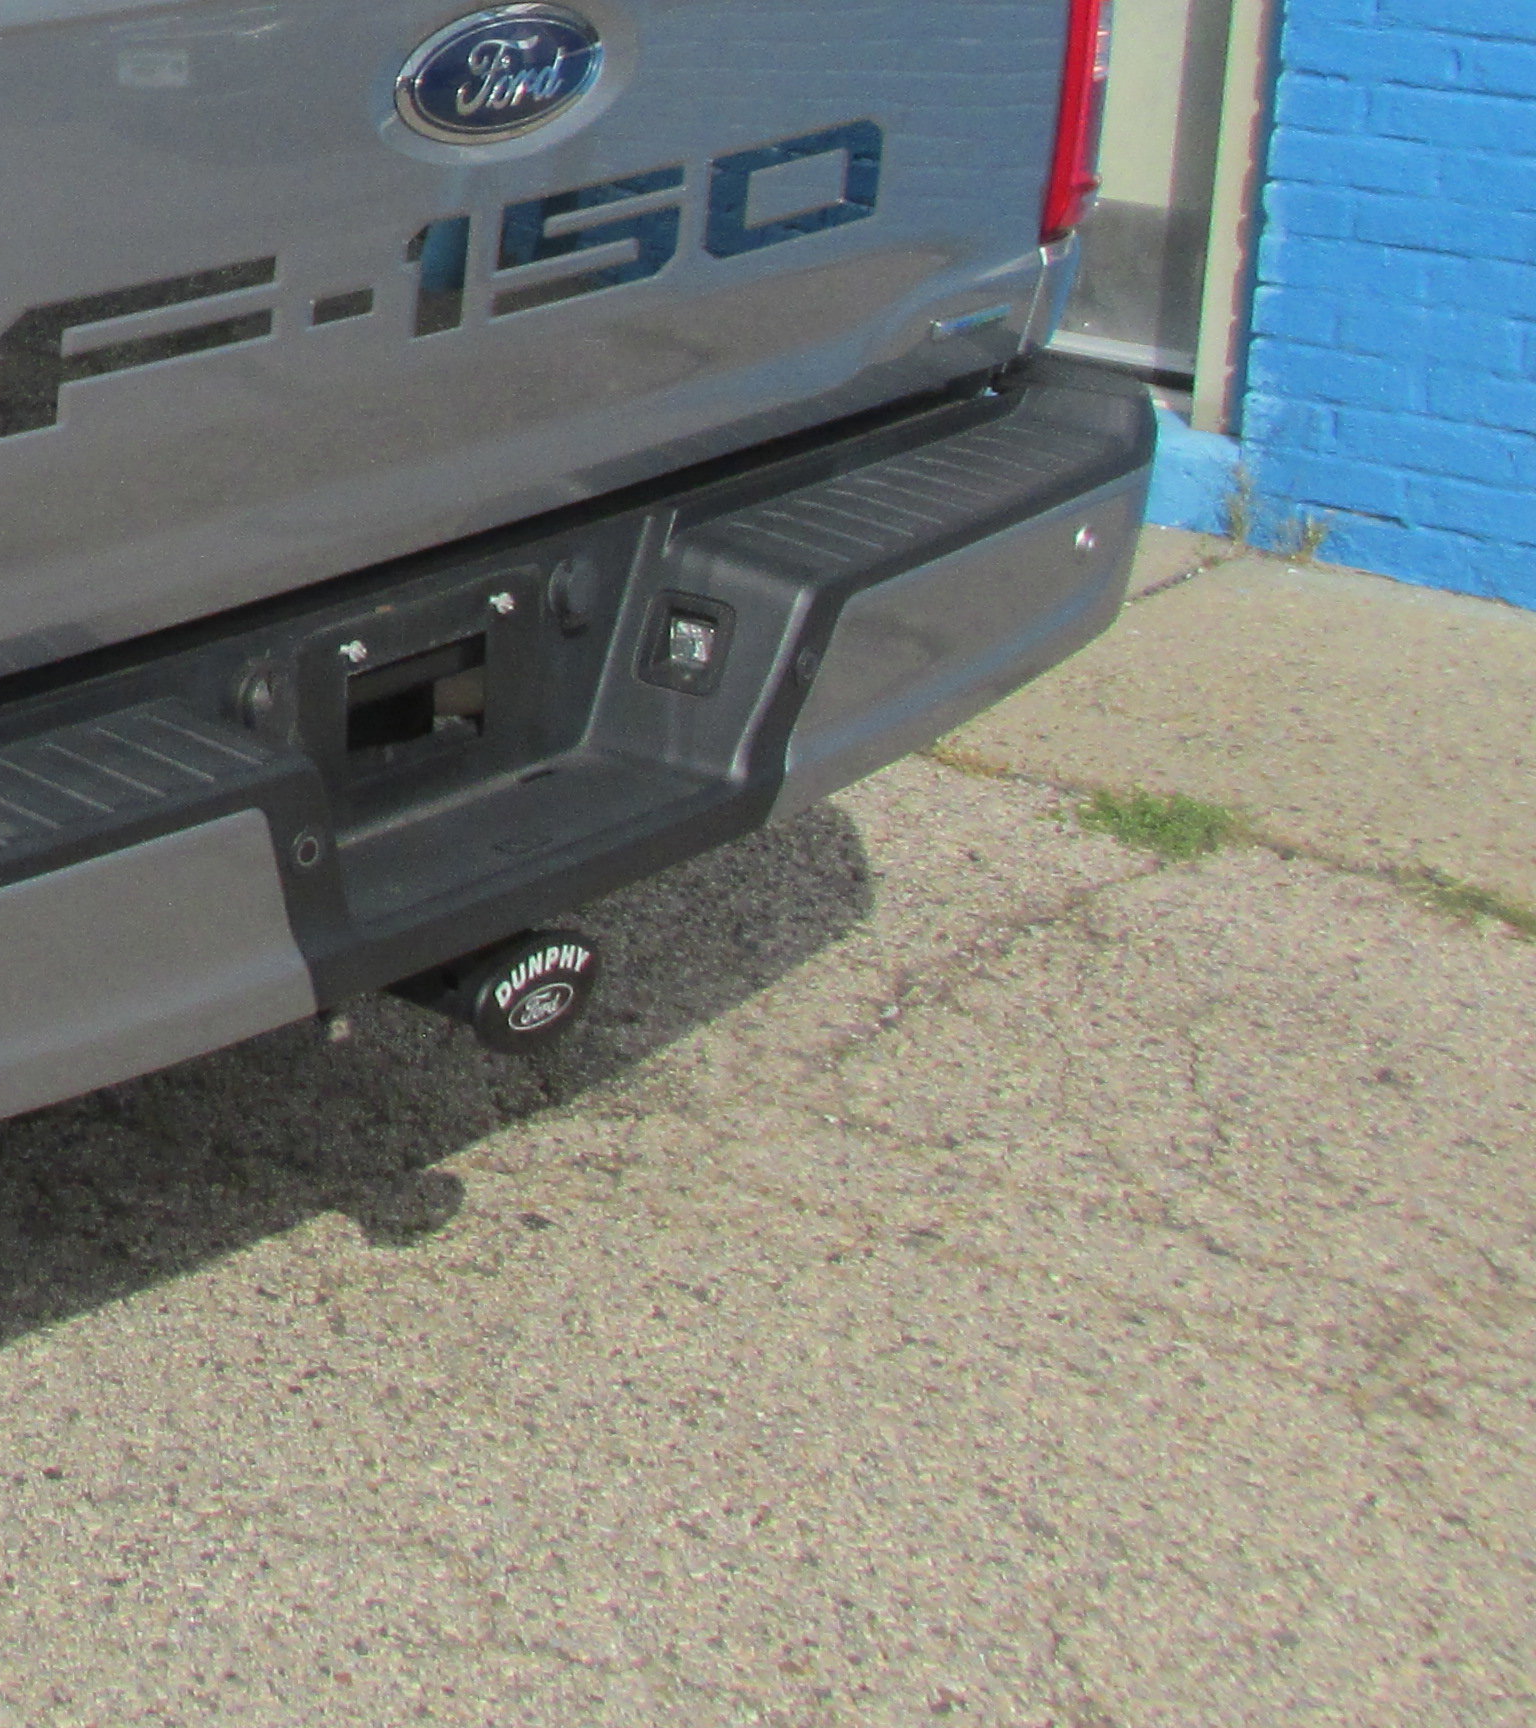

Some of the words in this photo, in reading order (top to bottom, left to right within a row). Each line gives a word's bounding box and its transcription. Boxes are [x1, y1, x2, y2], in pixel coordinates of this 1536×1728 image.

[456, 34, 565, 116] Ford
[495, 944, 590, 1009] DUNPHY
[521, 991, 562, 1025] Ford
